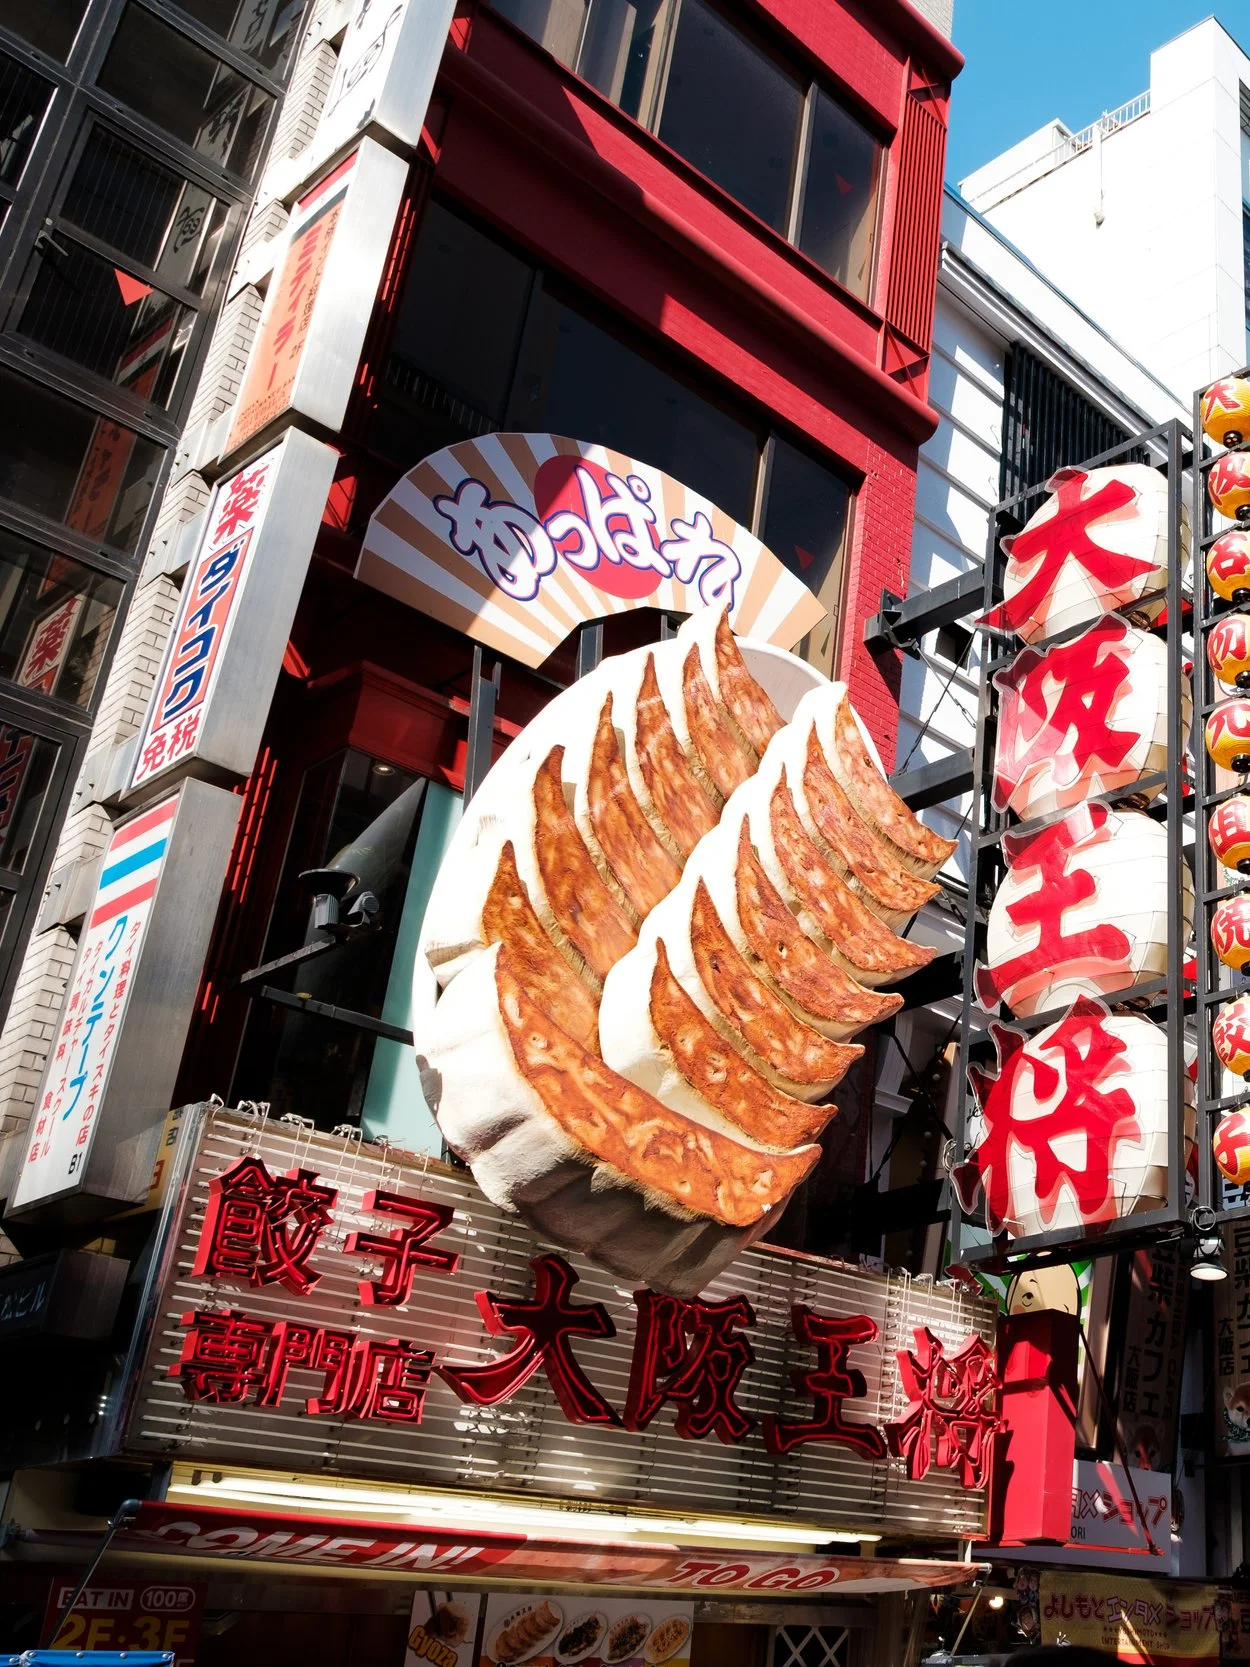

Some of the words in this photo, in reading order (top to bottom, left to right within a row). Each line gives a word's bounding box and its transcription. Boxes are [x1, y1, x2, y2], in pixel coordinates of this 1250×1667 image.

[434, 463, 741, 612] あっぱれ
[163, 538, 246, 721] ダイコク
[136, 708, 201, 781] 免税
[951, 465, 1165, 1238] 大阪王将
[63, 914, 129, 1121] クンテープ
[76, 920, 142, 1147] タイ料理とタイスキの店
[68, 1152, 82, 1174] B1
[192, 1156, 460, 1307] 餃子
[430, 1253, 1007, 1491] 大阪王将
[107, 1591, 131, 1608] IN
[408, 1624, 459, 1667] Gyoza
[664, 1561, 754, 1588] TO
[745, 1564, 841, 1593] GO
